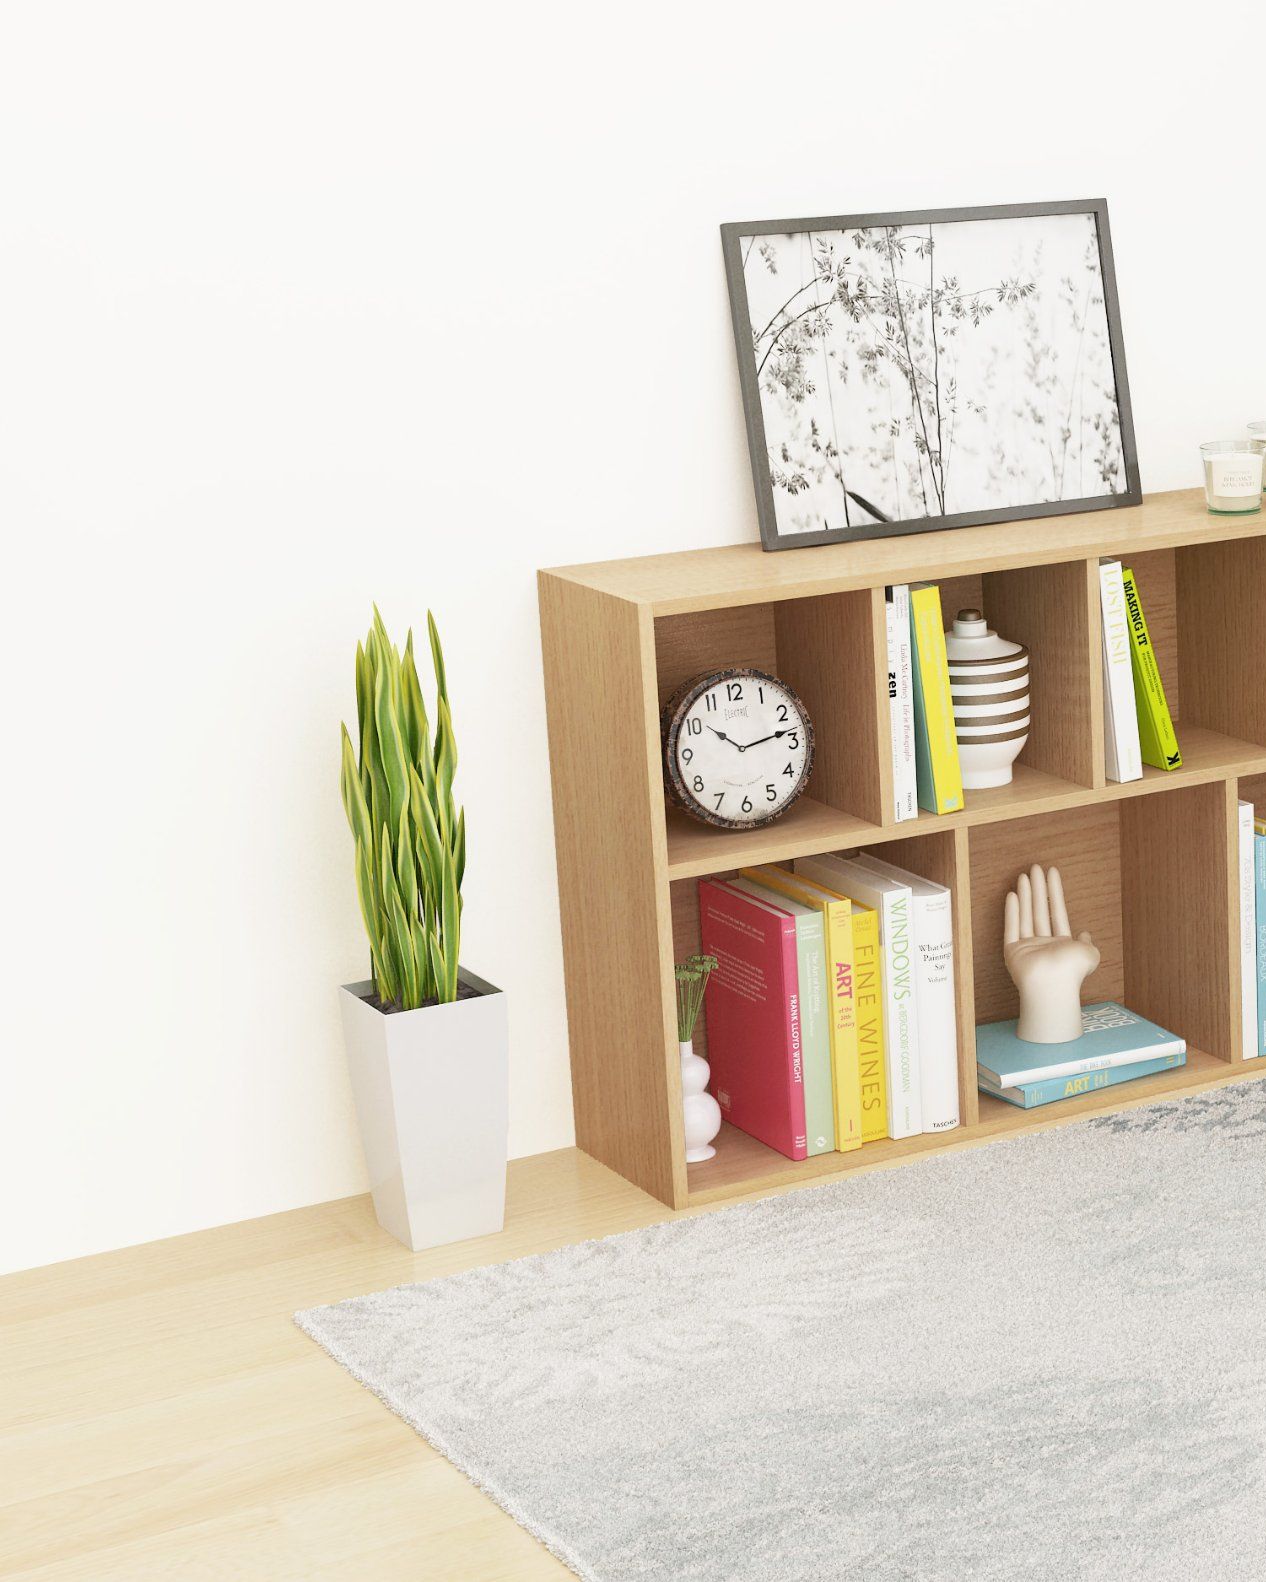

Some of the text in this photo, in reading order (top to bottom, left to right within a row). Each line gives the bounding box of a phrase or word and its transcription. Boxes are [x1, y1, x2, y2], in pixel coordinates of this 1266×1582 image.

[1123, 580, 1148, 646] MAKING IT
[727, 683, 743, 701] 12
[888, 672, 897, 698] zen
[705, 694, 716, 711] 11
[758, 687, 763, 704] 1
[776, 704, 789, 722] 2
[686, 718, 702, 736] 10
[787, 732, 799, 750] 3
[681, 748, 693, 766] 9
[782, 762, 794, 778] 4
[693, 775, 704, 792] 8
[766, 784, 777, 801] 5
[713, 792, 725, 810] 7
[741, 795, 753, 813] 6
[890, 898, 911, 1000] WINDOWS
[919, 943, 939, 952] What
[855, 944, 877, 1007] FINE
[934, 963, 945, 972] Say
[835, 962, 853, 999] ART
[837, 1021, 855, 1029] Century
[790, 994, 801, 1083] FRANK LLOYD WRIGHT
[859, 1018, 881, 1111] WINES
[1064, 1076, 1090, 1096] ART
